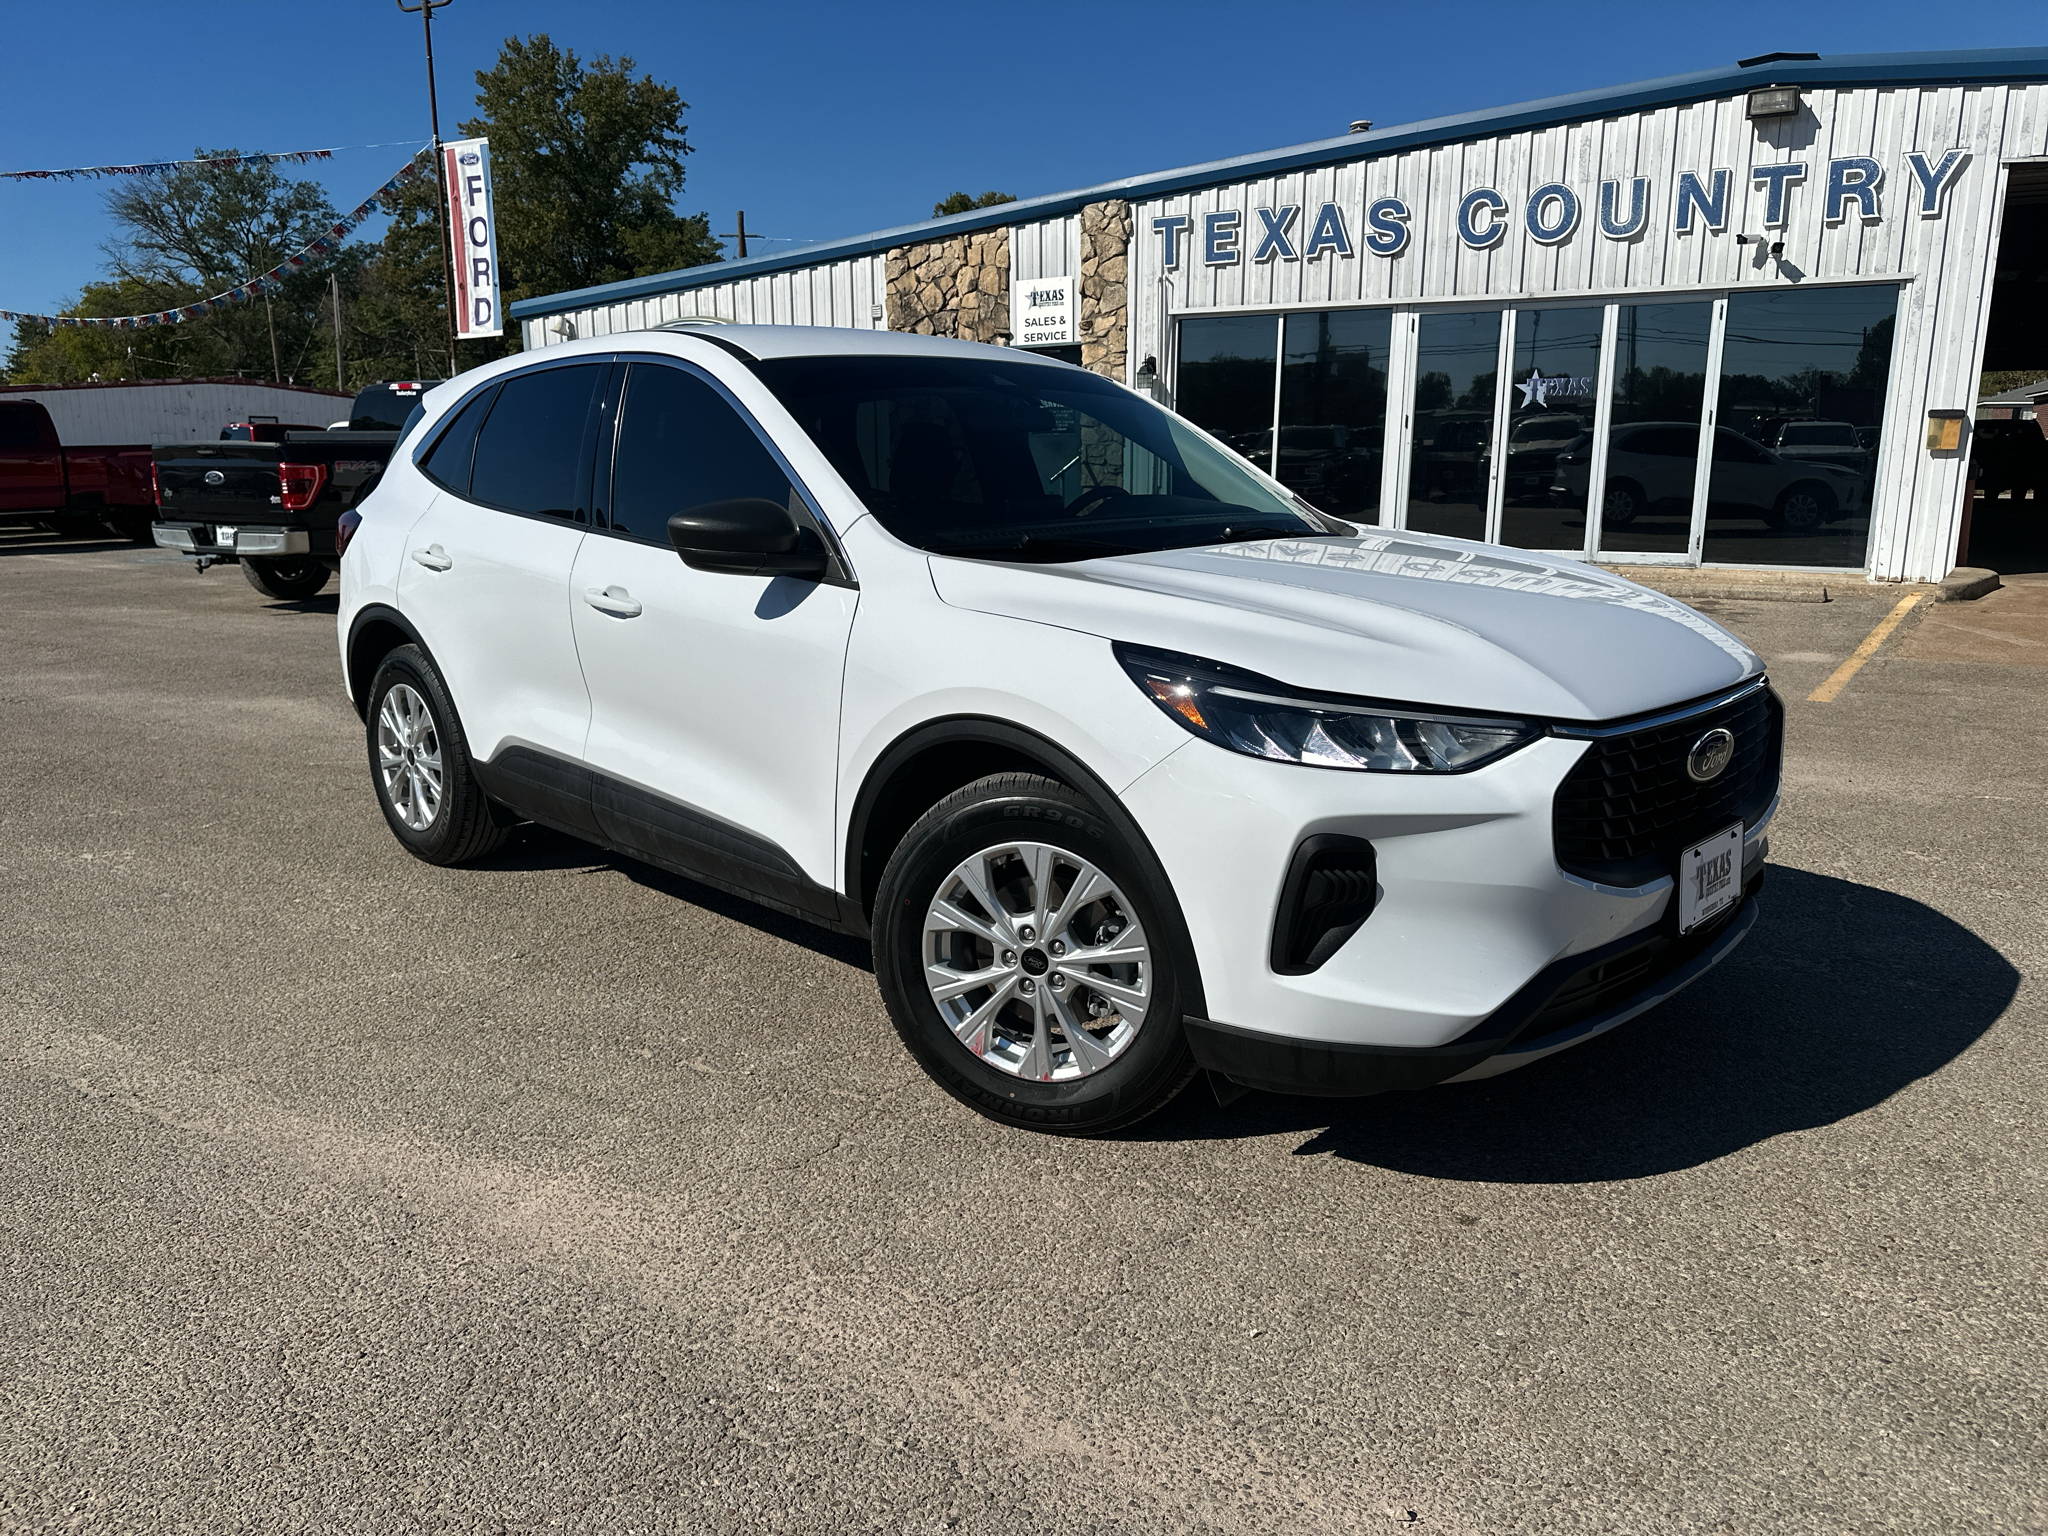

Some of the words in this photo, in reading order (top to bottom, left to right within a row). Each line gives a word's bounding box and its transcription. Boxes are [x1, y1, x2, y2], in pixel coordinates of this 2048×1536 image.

[1151, 196, 1408, 269] TEXAS
[1456, 147, 1969, 249] COUNTRY
[466, 174, 492, 326] FORD
[1030, 288, 1065, 307] TEXAS
[1024, 316, 1056, 328] SALES
[1059, 315, 1066, 325] &
[1024, 330, 1067, 343] SERVICE
[1527, 376, 1594, 402] TEXAS
[1702, 740, 1729, 772] Ford
[1002, 804, 1107, 840] GR906
[1696, 847, 1732, 901] TEXAS
[939, 1066, 1083, 1125] IRONMAN
